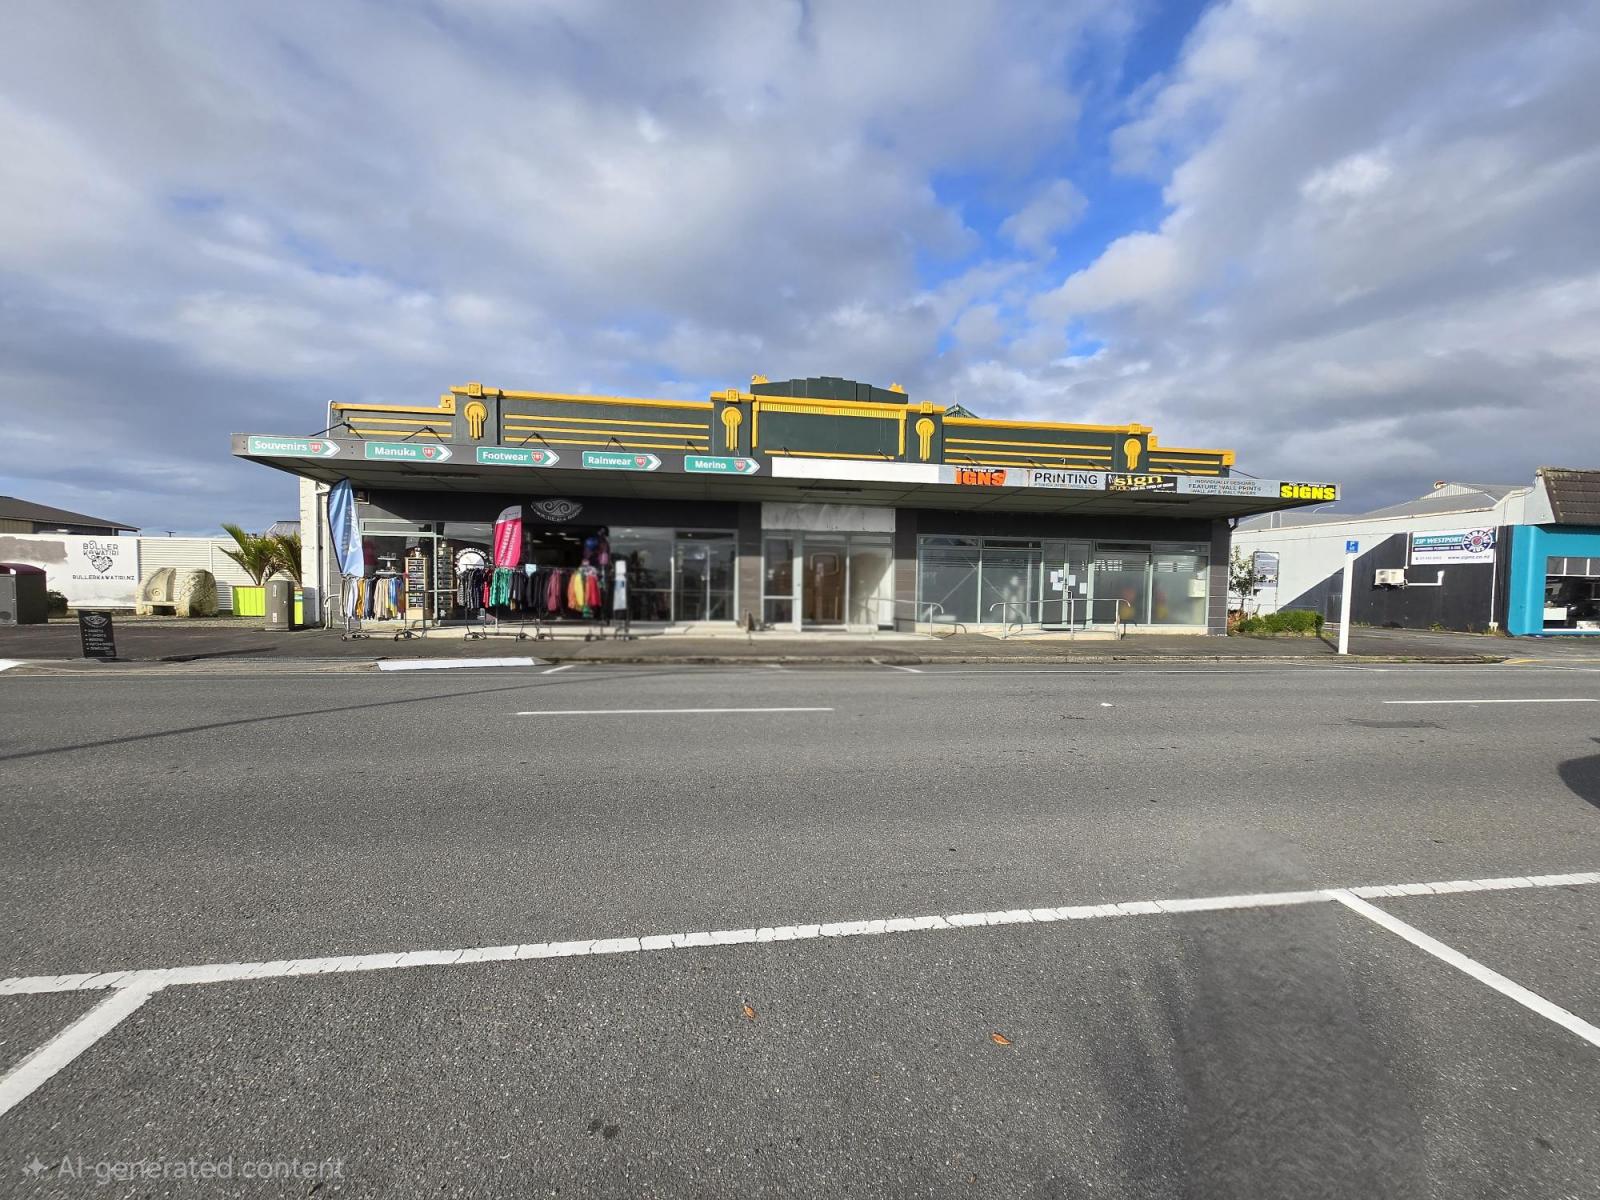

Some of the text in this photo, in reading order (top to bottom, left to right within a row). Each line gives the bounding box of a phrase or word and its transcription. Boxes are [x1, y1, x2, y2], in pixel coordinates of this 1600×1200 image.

[255, 441, 307, 451] Souvenirs
[374, 447, 416, 457] Manuka
[482, 451, 528, 461] Footwear
[588, 456, 632, 466] Rainwear
[695, 460, 727, 470] Merino
[1034, 472, 1098, 485] PRINTING
[1113, 475, 1163, 487] sign
[1281, 485, 1336, 500] SIGNS
[1427, 536, 1463, 544] WESTPORT
